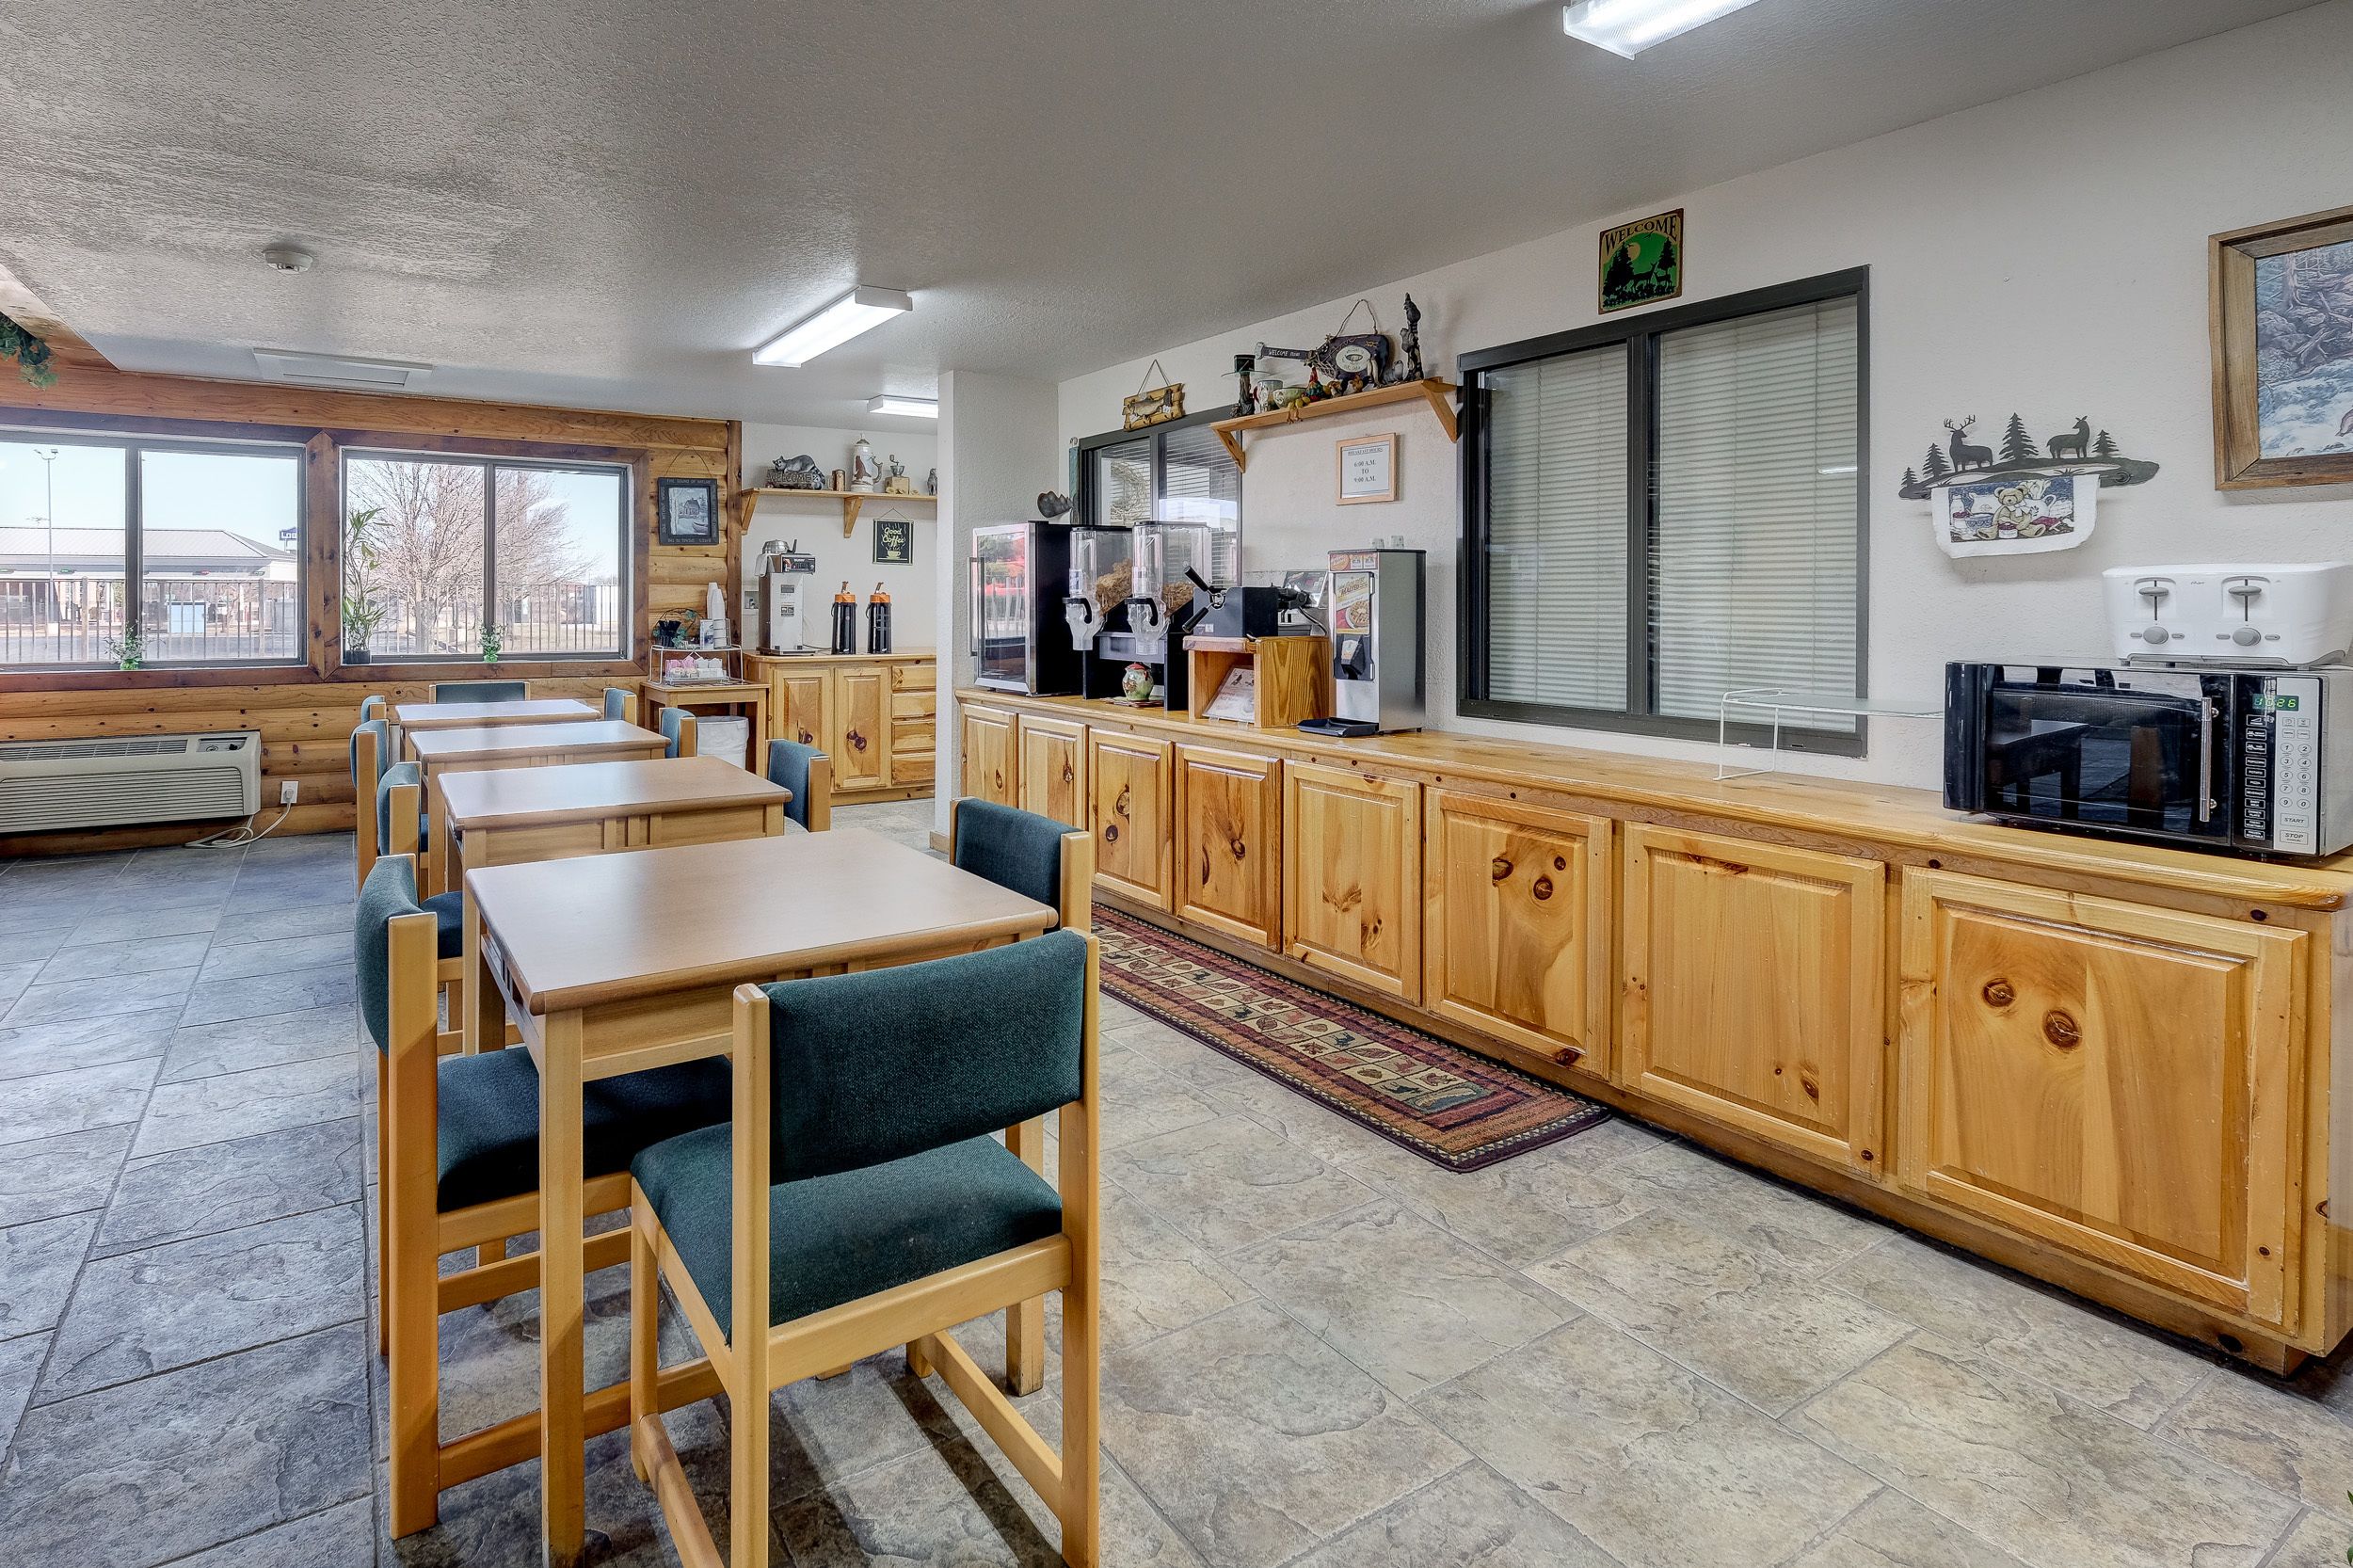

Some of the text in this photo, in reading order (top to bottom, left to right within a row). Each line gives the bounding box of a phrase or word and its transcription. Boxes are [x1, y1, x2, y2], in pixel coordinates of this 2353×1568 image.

[1605, 215, 1677, 256] WELCOME
[768, 473, 812, 483] WELCOME
[883, 536, 904, 546] Coffee
